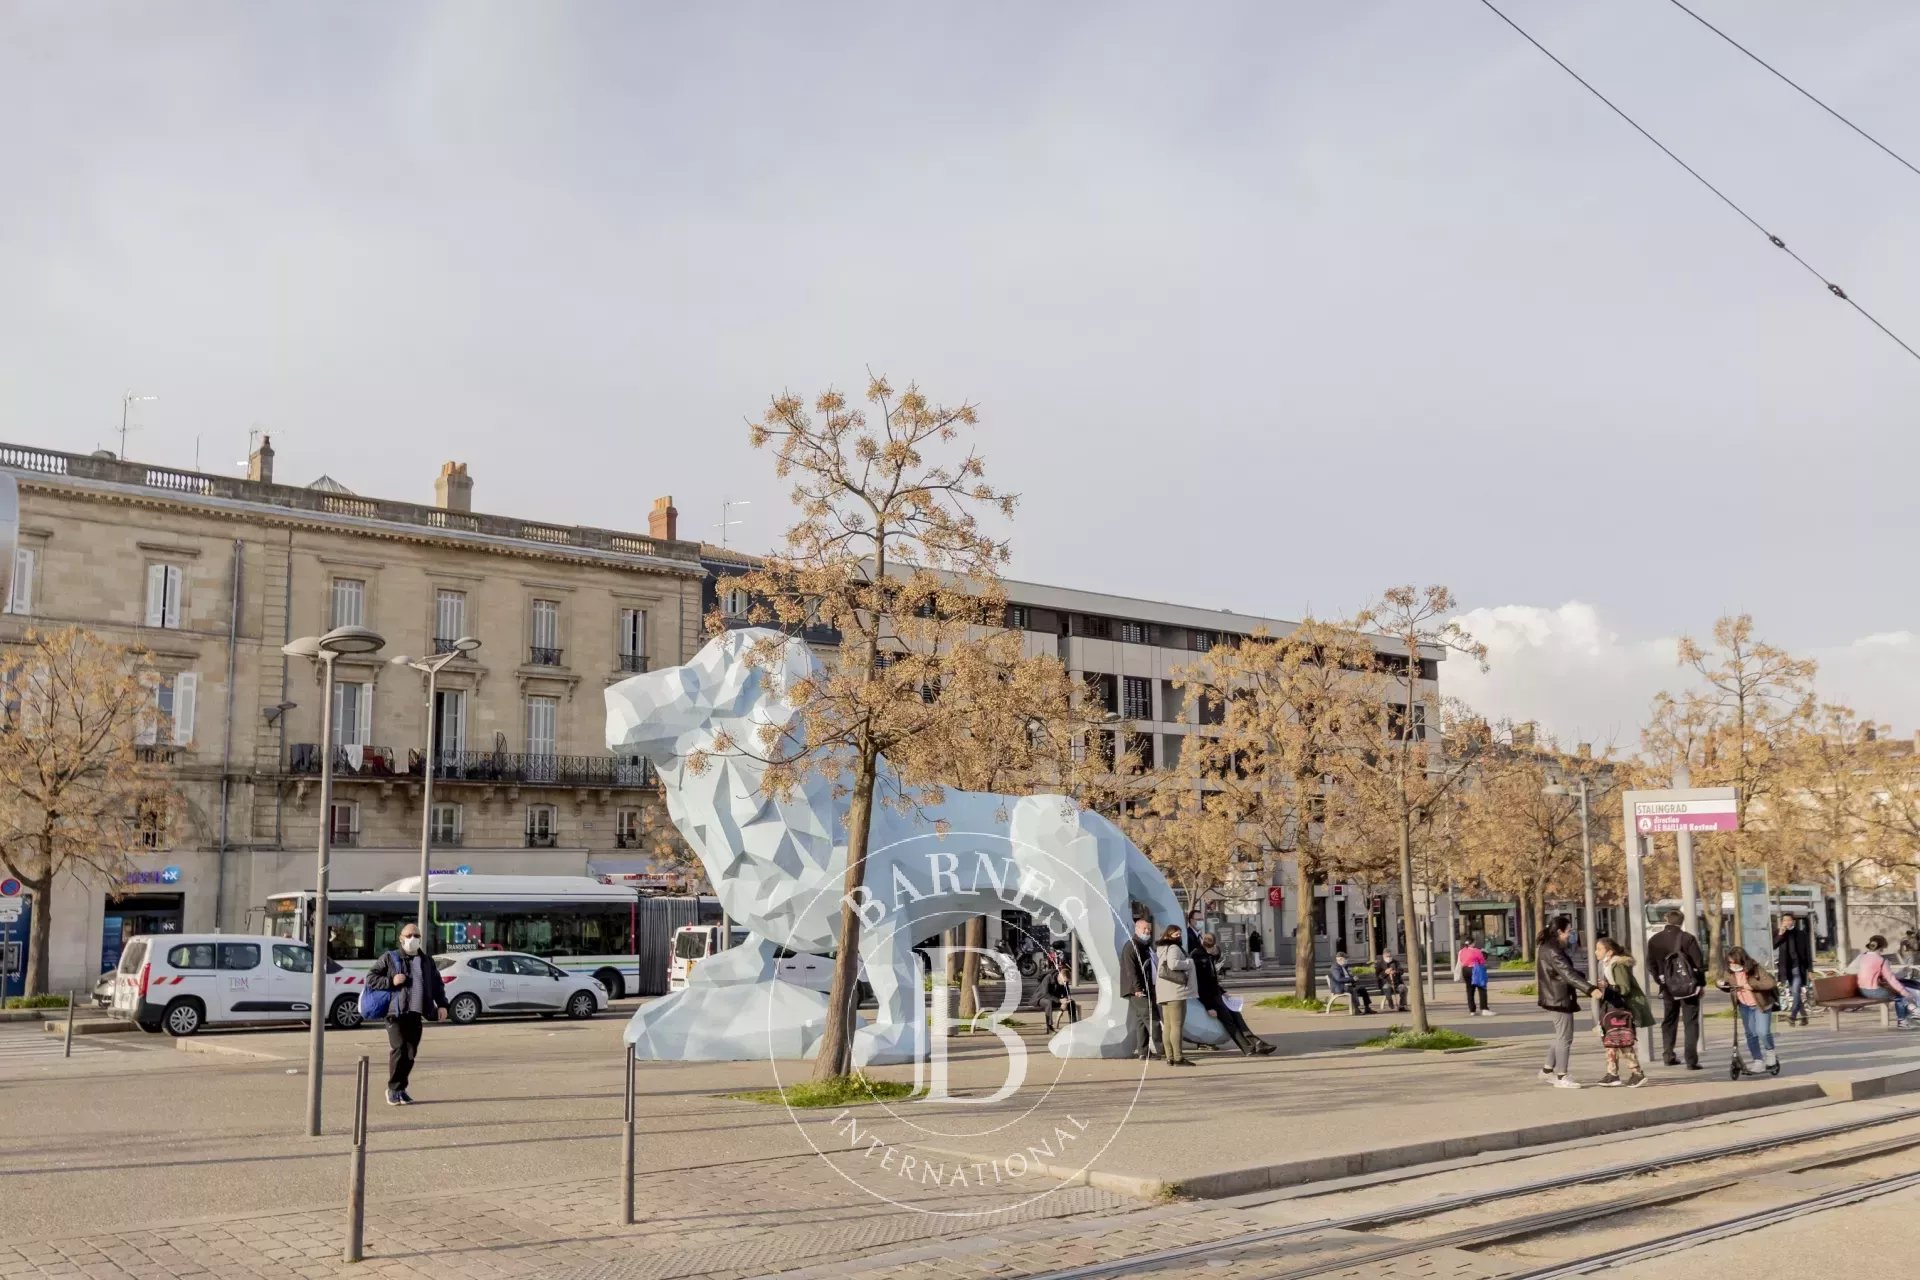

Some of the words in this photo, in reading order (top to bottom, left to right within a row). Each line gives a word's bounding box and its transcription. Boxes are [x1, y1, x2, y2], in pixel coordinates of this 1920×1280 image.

[1637, 804, 1688, 814] STALINGRAD
[1653, 816, 1680, 824] direction
[228, 976, 249, 988] TBM
